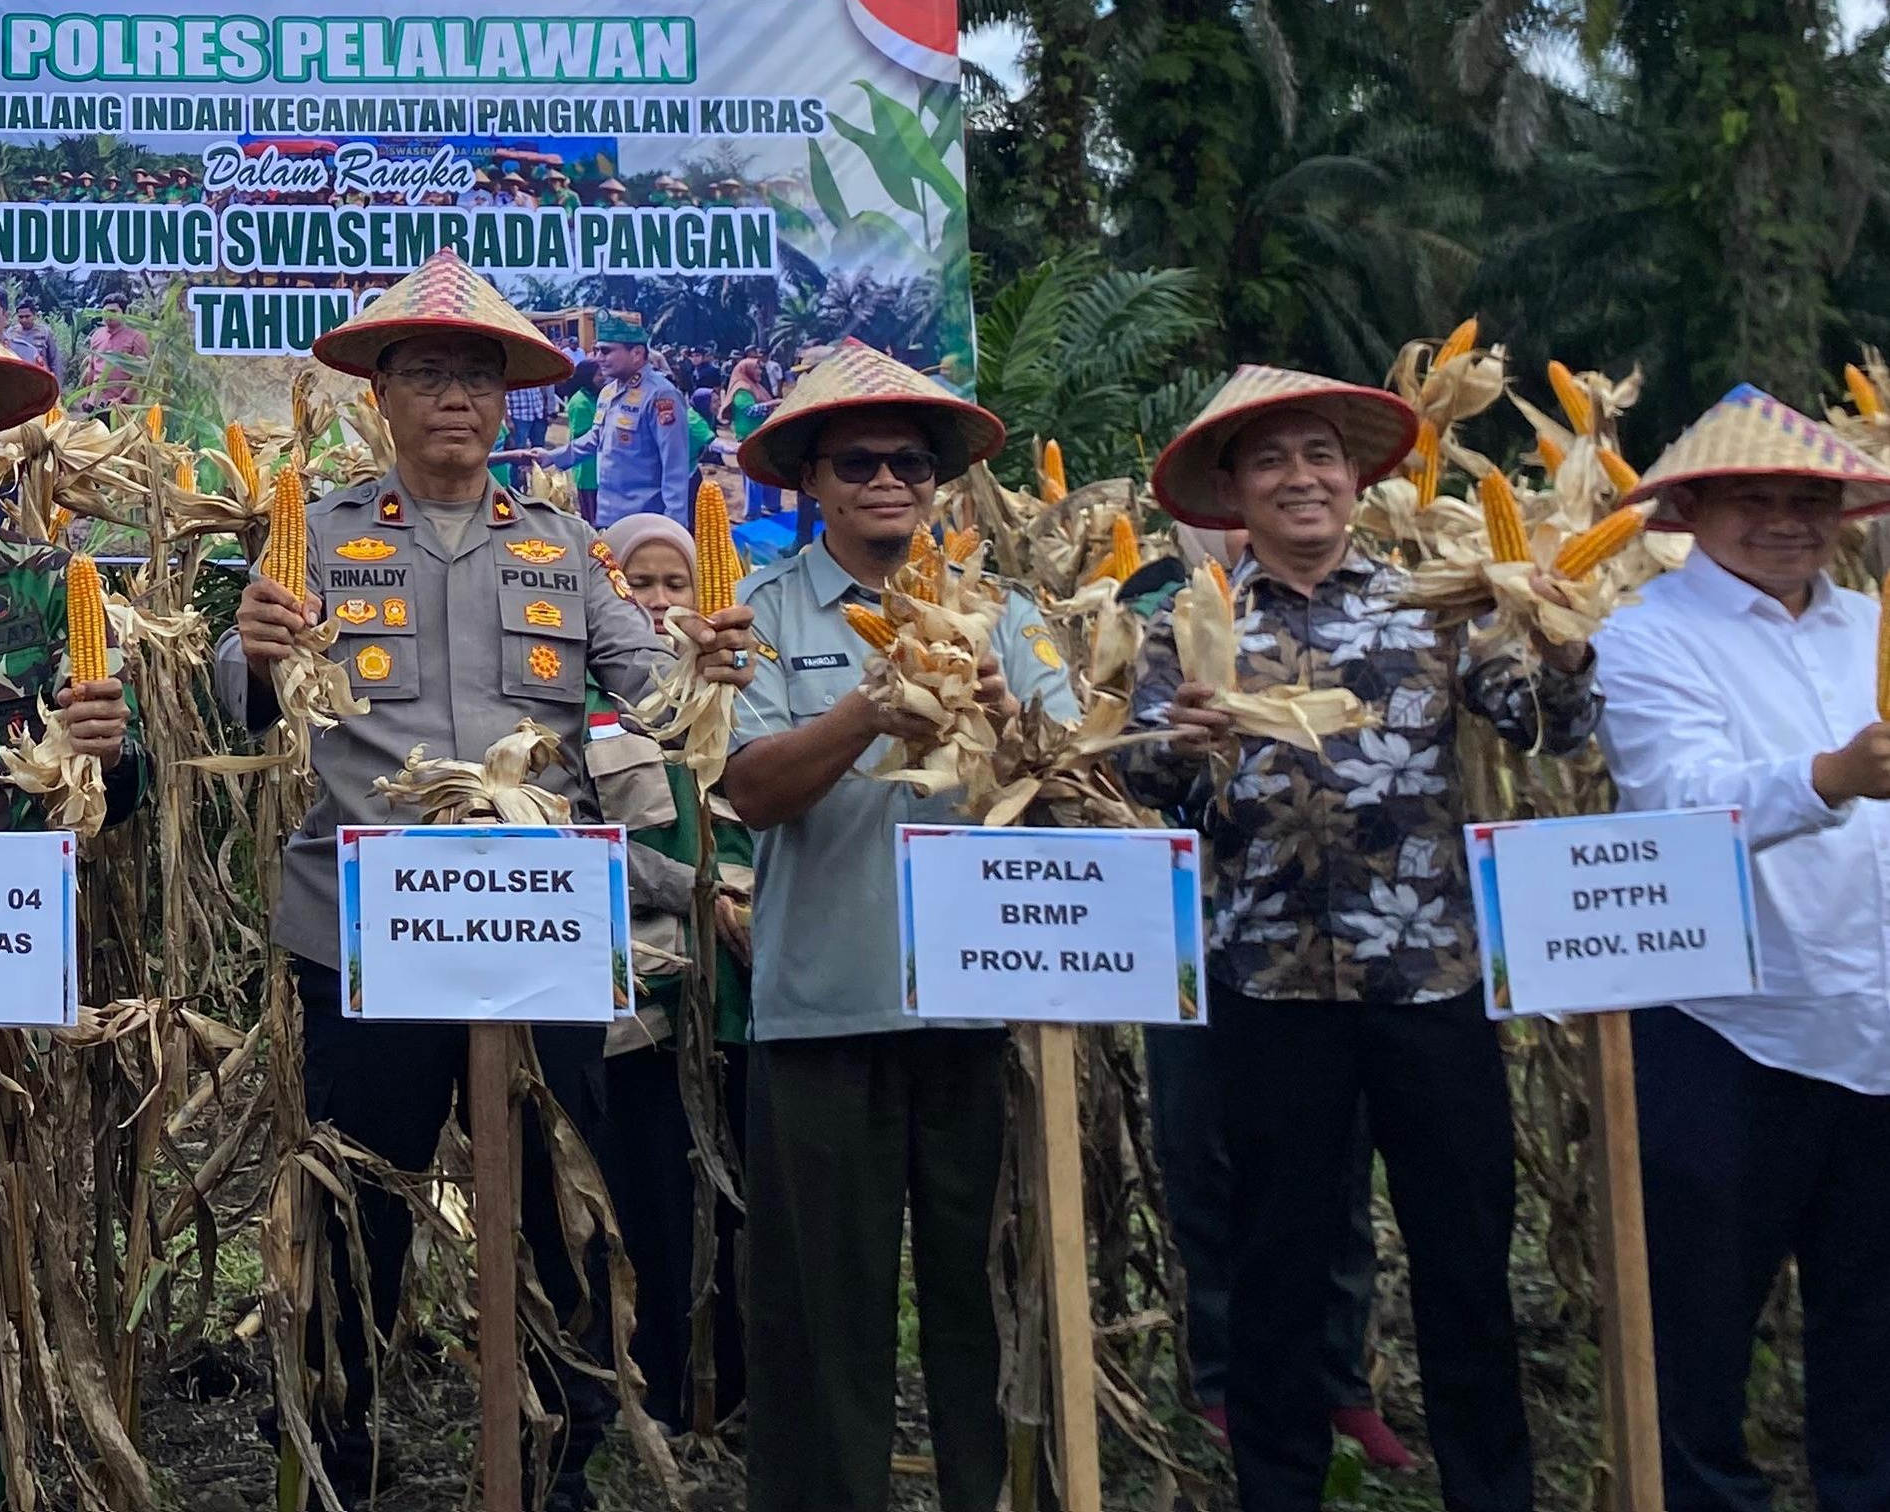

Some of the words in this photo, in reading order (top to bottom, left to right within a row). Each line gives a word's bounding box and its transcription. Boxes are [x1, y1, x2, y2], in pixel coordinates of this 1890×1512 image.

[9, 17, 266, 79] POLRES
[281, 19, 689, 80] PELALAWAN
[131, 96, 243, 132] INDAH
[253, 97, 467, 133] KECAMATAN
[478, 98, 690, 134] PANGKALAN
[700, 98, 827, 134] KURAS
[205, 145, 325, 188] Dalam
[338, 146, 474, 200] Rangka
[225, 209, 569, 269] SWASEMBADA
[580, 212, 771, 270] PANGAN
[192, 293, 350, 350] TAHUN
[330, 567, 407, 588] RINALDY
[501, 569, 578, 592] POLRI
[1570, 839, 1659, 866] KADIS
[394, 868, 575, 893] KAPOLSEK
[981, 859, 1104, 882] KEPALA
[7, 887, 43, 910] 04
[1572, 884, 1669, 911] DPTPH
[1000, 903, 1089, 925] BRMP
[390, 917, 582, 943] PKL.KURAS
[1545, 936, 1628, 962] PROV.
[1636, 927, 1708, 954] RIAU
[960, 949, 1049, 972] PROV.
[1060, 951, 1135, 973] RIAU
